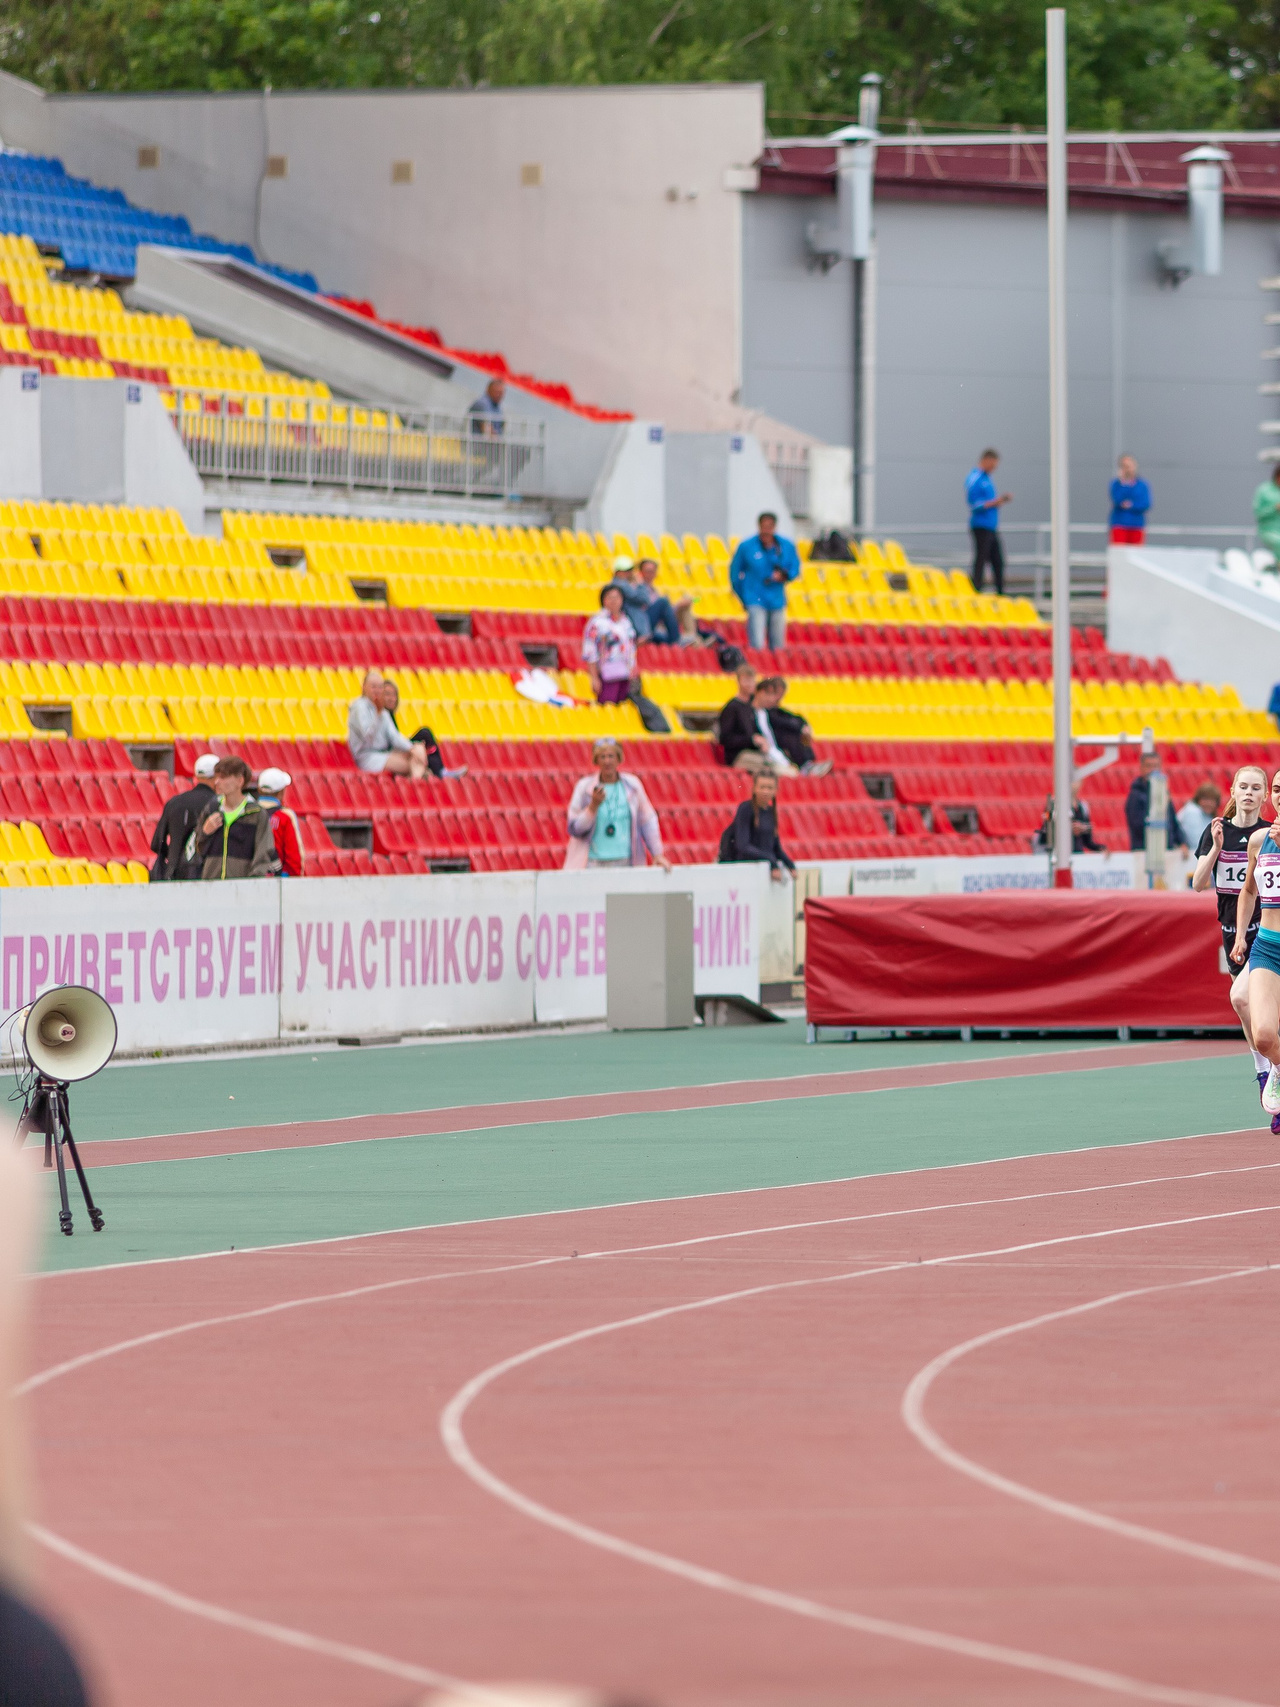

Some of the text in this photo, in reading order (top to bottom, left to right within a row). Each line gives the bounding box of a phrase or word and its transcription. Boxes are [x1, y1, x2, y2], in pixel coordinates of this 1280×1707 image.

[2, 889, 750, 1010] ПРИВЕТСТВУЕМ УЧАСТНИКОВ СОРЕВНИЙ!
